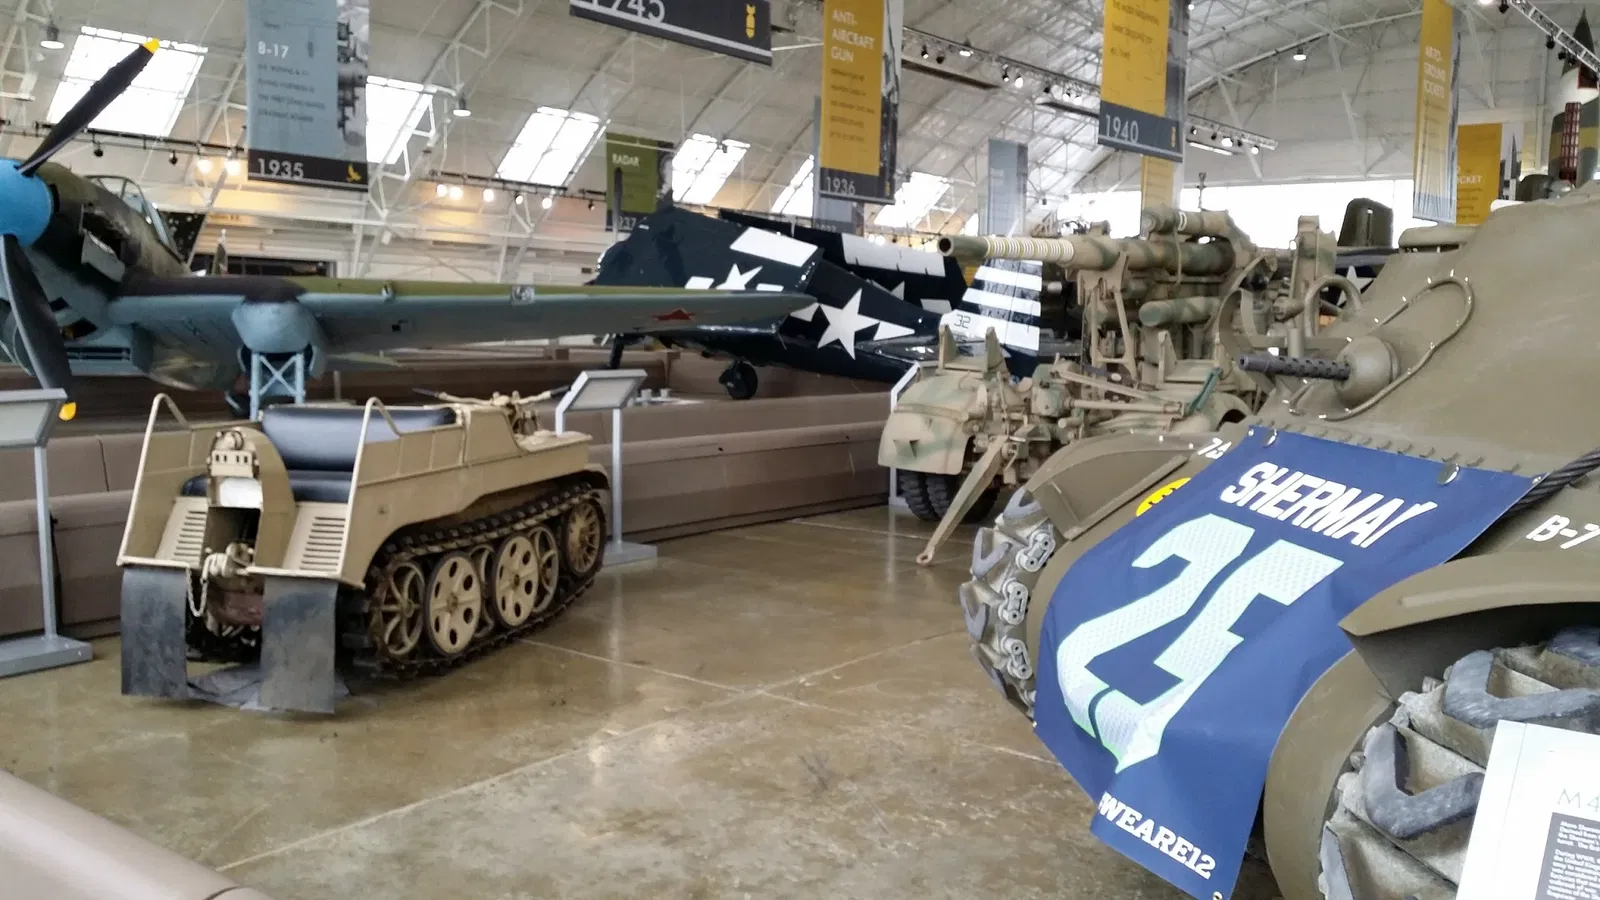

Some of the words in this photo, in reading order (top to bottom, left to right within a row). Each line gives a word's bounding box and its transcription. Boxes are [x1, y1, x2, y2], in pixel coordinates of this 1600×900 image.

[832, 28, 875, 50] AIRCRAFT
[258, 41, 289, 59] B-17
[831, 46, 855, 63] GUN
[1105, 114, 1139, 144] 1940
[257, 158, 304, 179] 1935
[826, 176, 856, 196] 1936
